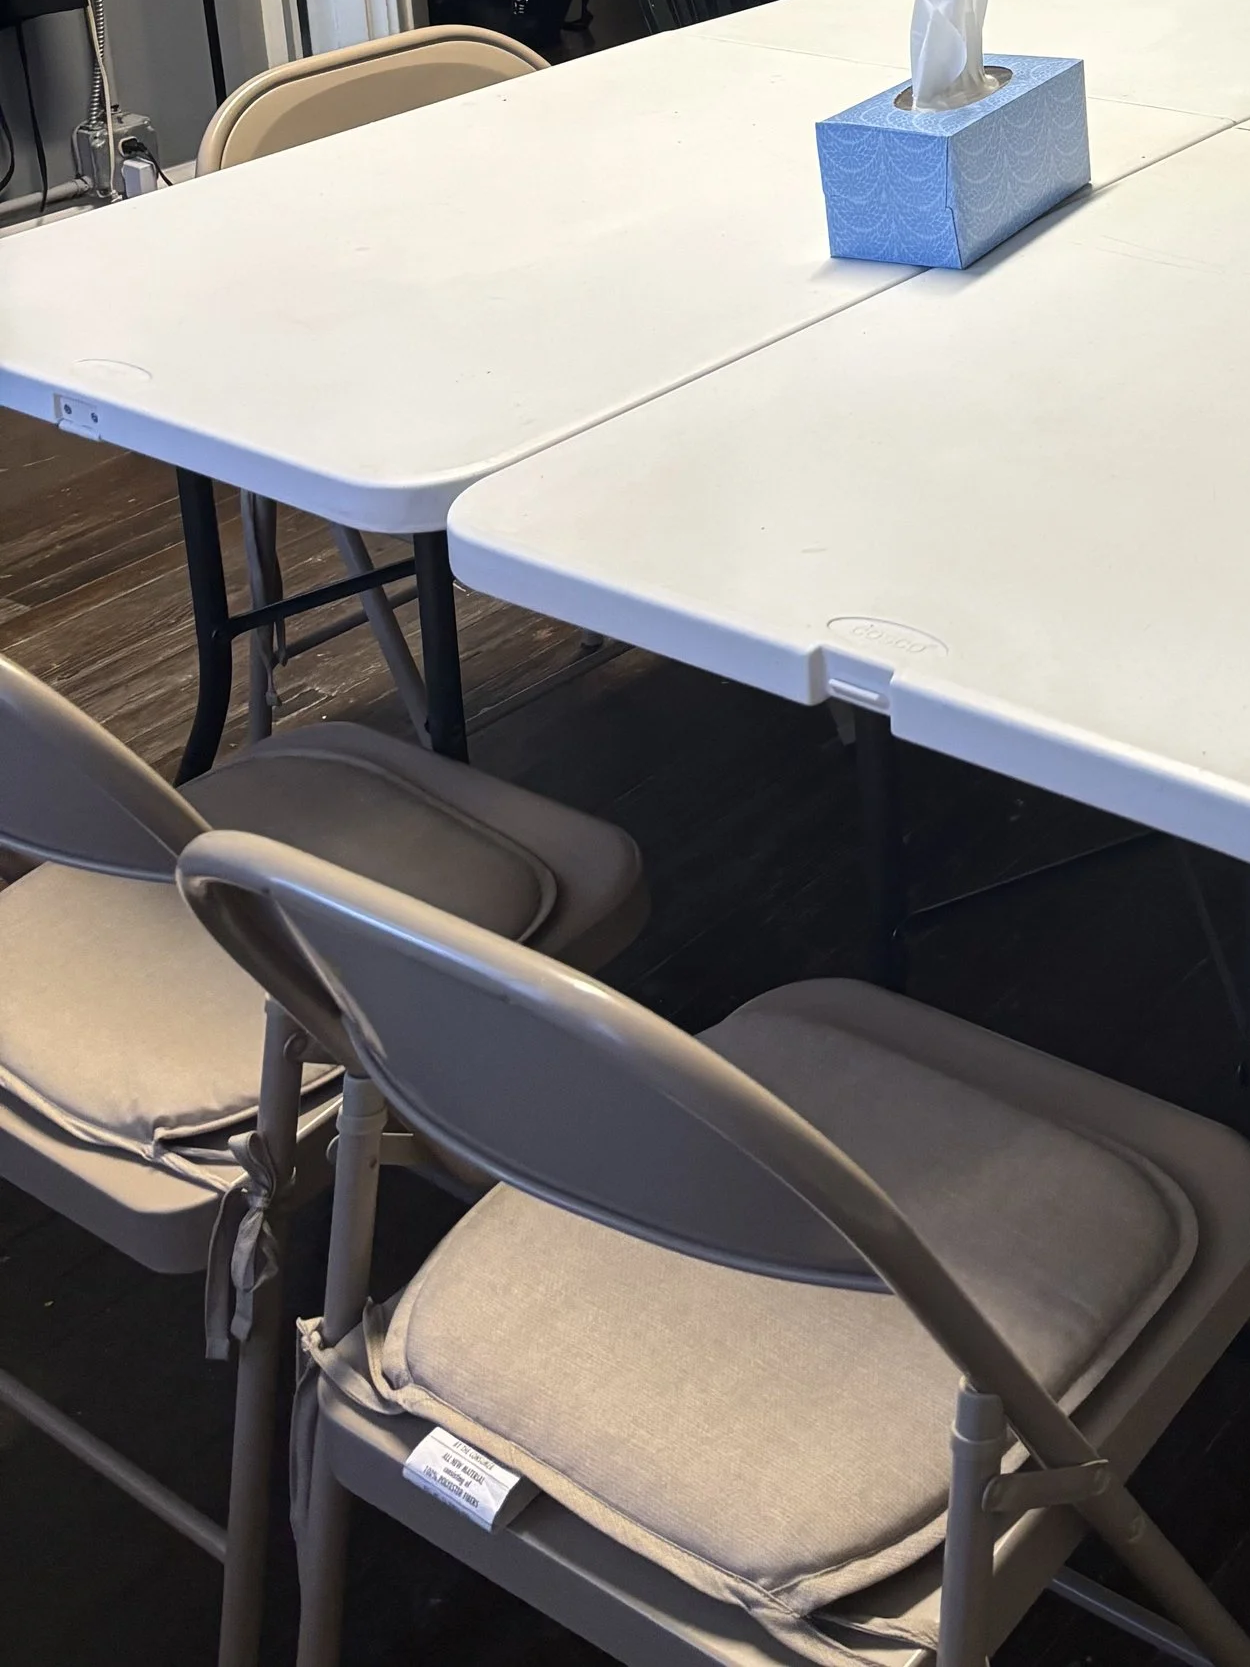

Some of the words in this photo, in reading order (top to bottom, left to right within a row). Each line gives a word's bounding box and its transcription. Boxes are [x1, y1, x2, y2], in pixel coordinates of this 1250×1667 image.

[443, 1452, 451, 1463] ALL
[450, 1458, 463, 1469] NEW
[461, 1466, 486, 1485] MATERIAL
[437, 1475, 464, 1496] POLYESTER
[462, 1492, 479, 1508] FIBERS
